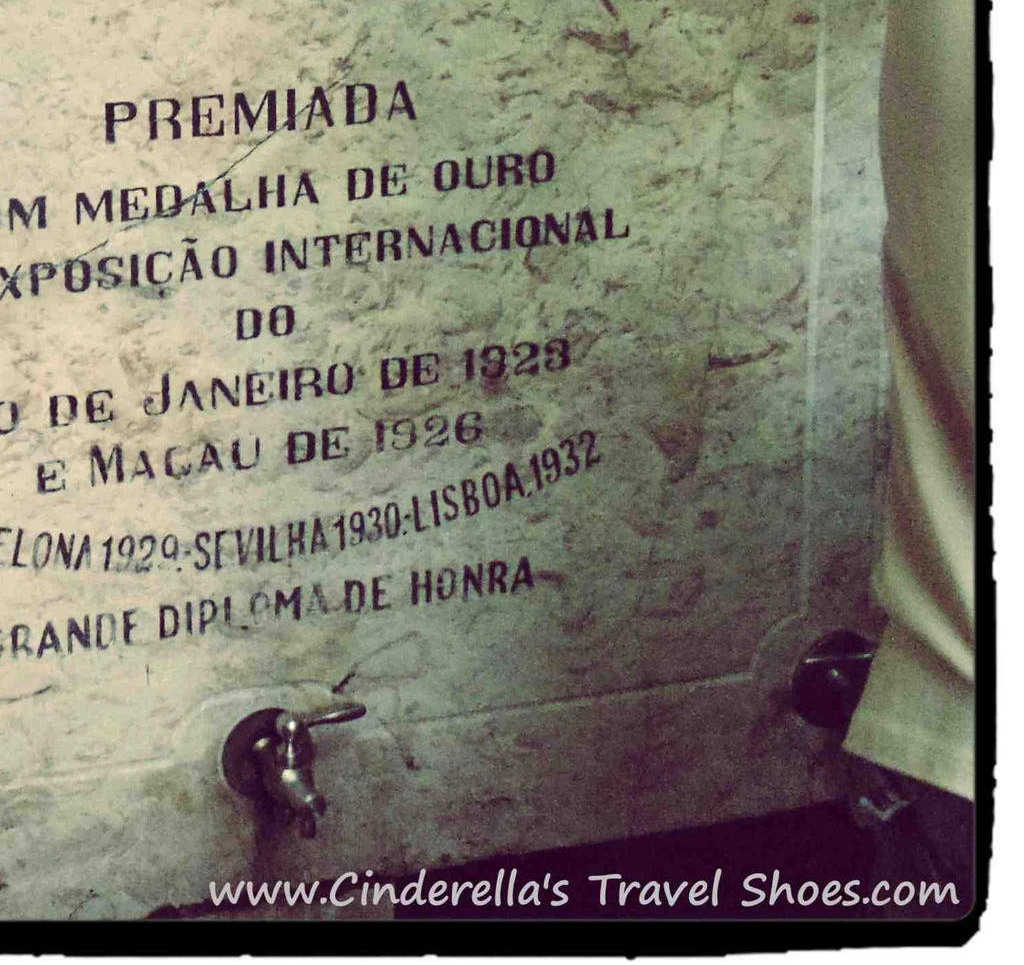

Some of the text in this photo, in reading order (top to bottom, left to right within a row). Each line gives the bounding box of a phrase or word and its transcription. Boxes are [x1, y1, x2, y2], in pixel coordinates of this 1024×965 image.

[104, 80, 417, 144] PREMIADA
[76, 170, 319, 225] MEDALHA
[347, 164, 407, 202] DE
[433, 149, 556, 192] OURO
[265, 208, 630, 274] INTERNACIONAL
[237, 303, 296, 341] DO
[49, 389, 115, 428] DE
[380, 352, 440, 391] DE
[37, 460, 67, 494] E
[287, 426, 350, 465] DE
[375, 410, 484, 454] 1926
[344, 574, 393, 614] DE
[410, 556, 535, 607] HONRA
